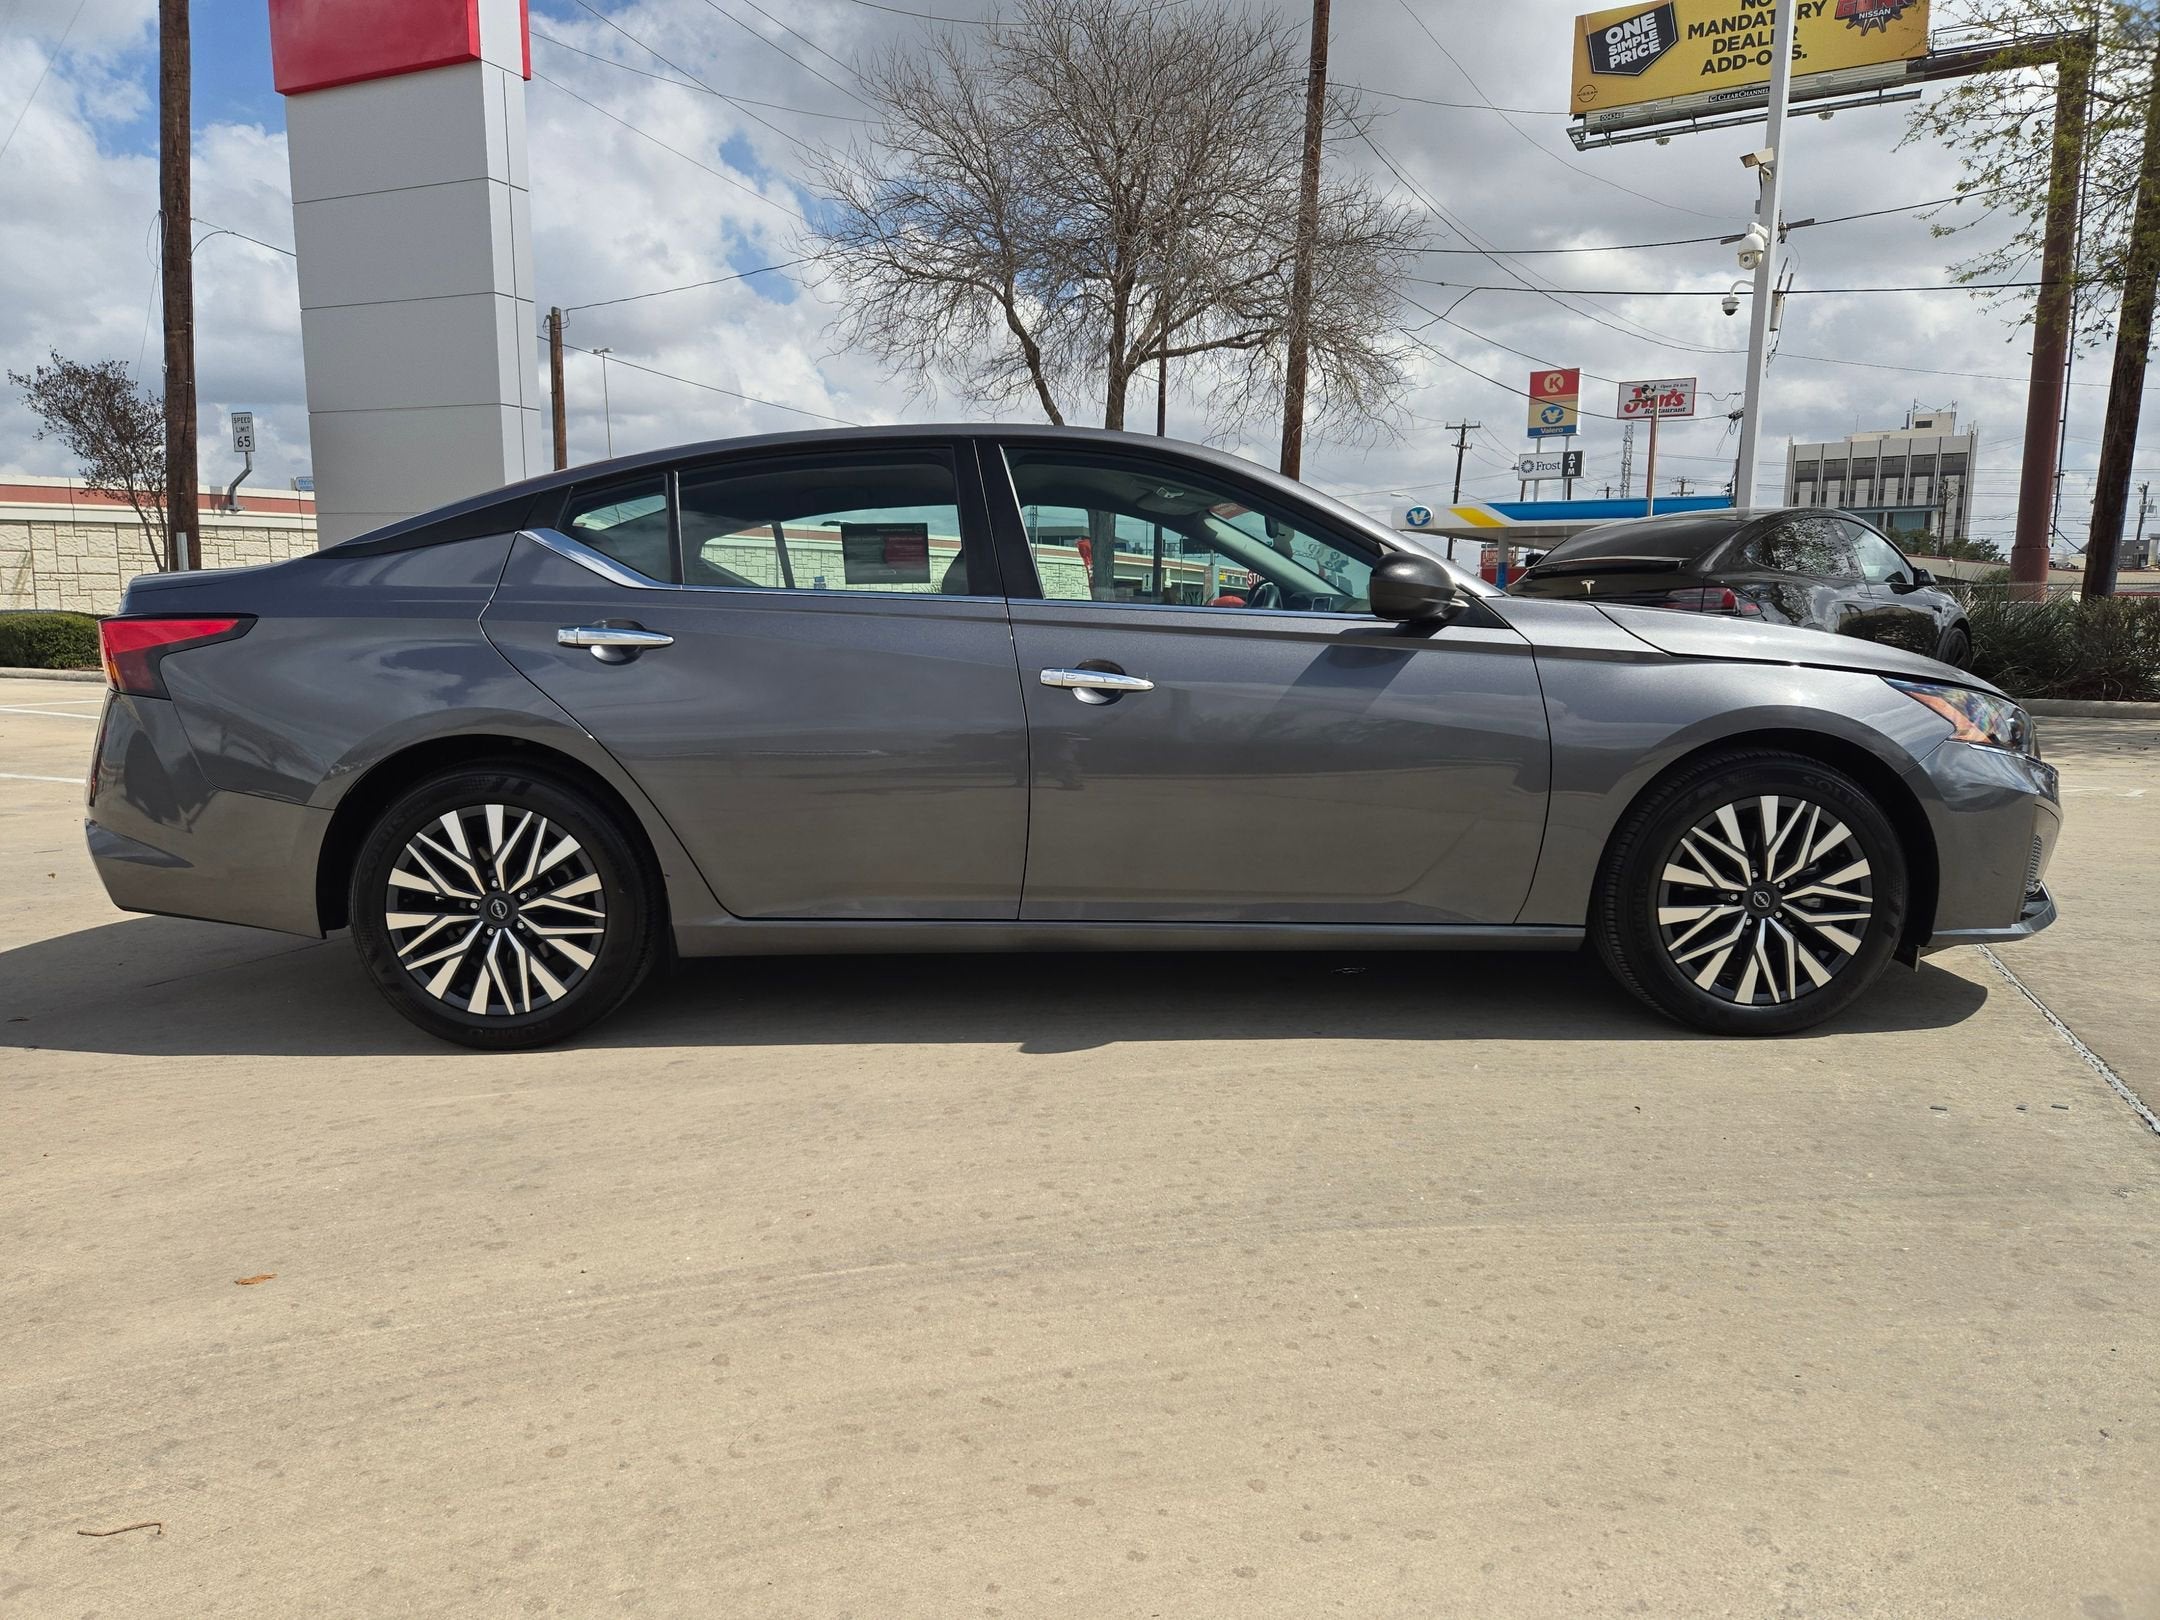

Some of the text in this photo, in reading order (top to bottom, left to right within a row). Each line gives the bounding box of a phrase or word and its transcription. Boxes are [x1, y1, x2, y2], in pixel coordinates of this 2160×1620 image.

[1688, 0, 1828, 40] MANDATRY
[1859, 8, 1891, 20] NISSAN
[1605, 12, 1657, 45] ONE
[1609, 29, 1658, 56] SIMPLE
[1609, 40, 1661, 69] PRICE
[1700, 44, 1807, 76] ADD-OS.
[1644, 407, 1687, 415] Retaurant
[237, 435, 251, 448] 65
[1535, 461, 1561, 471] Frost
[1567, 453, 1576, 475] ATM
